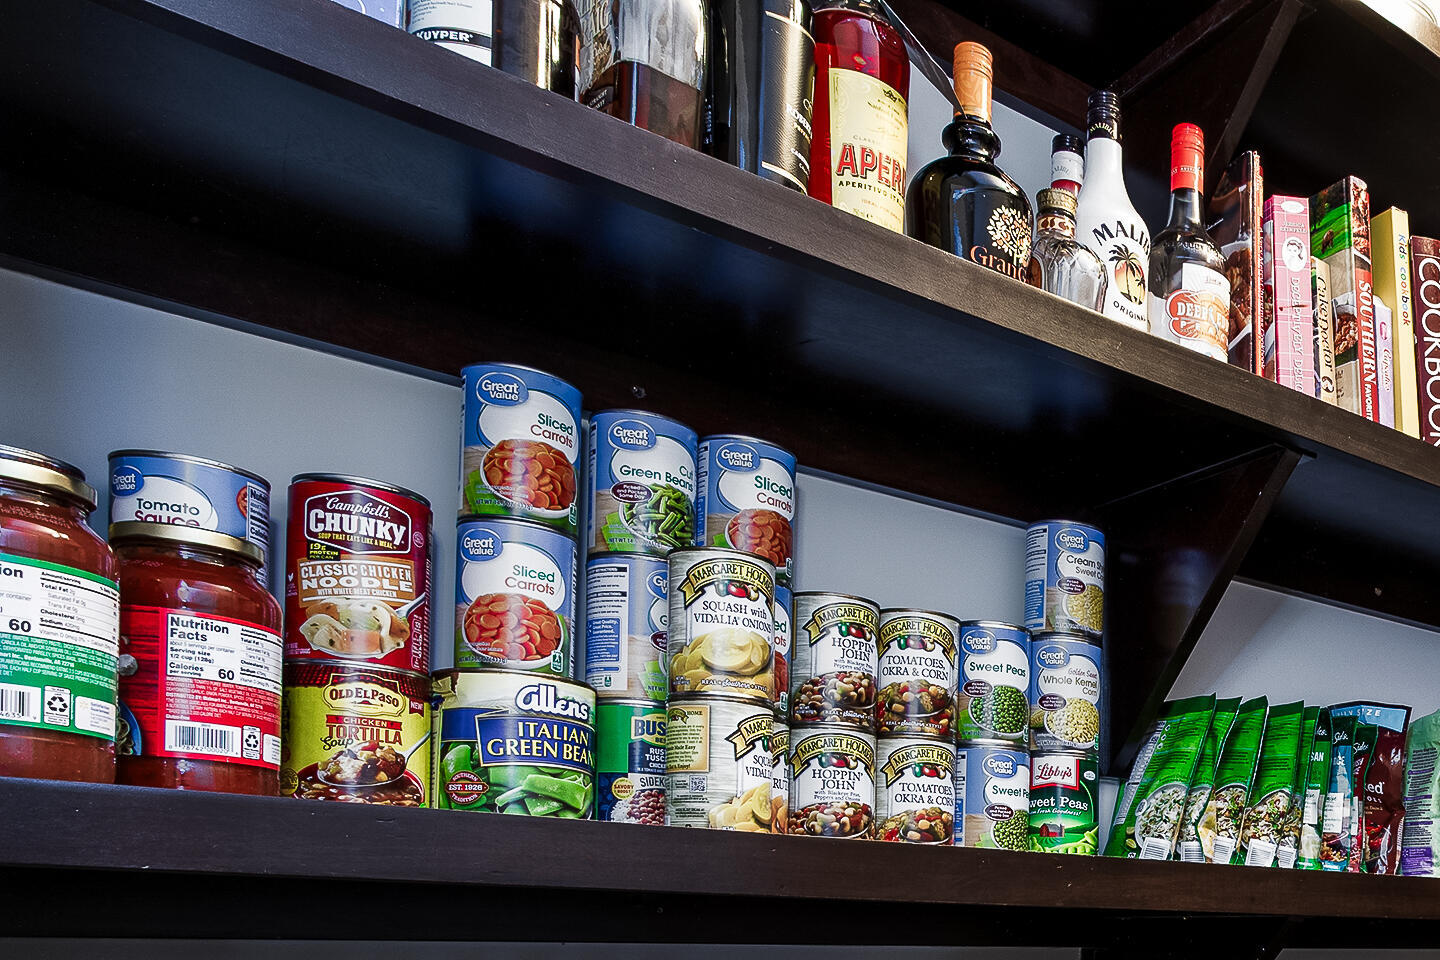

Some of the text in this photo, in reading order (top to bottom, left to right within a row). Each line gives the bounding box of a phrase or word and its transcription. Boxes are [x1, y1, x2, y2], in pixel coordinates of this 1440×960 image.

[1092, 220, 1150, 256] MALIB
[1398, 234, 1410, 326] Kids' cookbook
[1358, 280, 1377, 385] SOUTHERN
[482, 379, 519, 394] Great
[489, 389, 519, 401] Value
[537, 412, 573, 436] Sliced
[530, 425, 573, 448] Carrots
[613, 426, 649, 439] Great
[620, 436, 649, 446] Value
[721, 450, 753, 461] Great
[728, 458, 753, 467] Value
[112, 473, 136, 484] Great
[620, 464, 693, 492] Green Beans
[679, 465, 693, 480] Cut
[115, 480, 136, 490] Value
[754, 475, 793, 500] Sliced
[136, 498, 200, 516] Tomato
[757, 493, 792, 513] Carrots
[309, 509, 406, 545] CHUNKY
[464, 537, 494, 548] Great
[1060, 533, 1084, 544] Great
[469, 546, 493, 556] Value
[1066, 555, 1096, 568] Cream
[301, 564, 411, 581] CLASSIC CHICKEN
[512, 565, 555, 583] Sliced
[692, 563, 744, 583] MARGARET
[302, 576, 413, 592] NOODLE
[504, 577, 555, 595] Carrots
[702, 601, 747, 615] SQUASH
[694, 613, 738, 626] VIDALIA
[742, 617, 772, 634] ONIONS
[817, 608, 862, 624] MARGARET
[9, 618, 32, 633] 60
[170, 617, 229, 634] Nutrition
[881, 621, 951, 645] MARGARET HOLMES
[170, 628, 208, 642] Facts
[965, 636, 991, 644] Great
[169, 646, 211, 657] Serving size
[832, 637, 875, 653] HOPPIN'
[841, 648, 870, 662] JOHN
[1040, 651, 1065, 660] Great
[169, 661, 204, 672] Calories
[882, 667, 948, 680] OKRA CORN
[969, 662, 1026, 677] Sweet Peas
[218, 669, 235, 681] 60
[1043, 675, 1098, 689] Whole Kernel
[1082, 687, 1098, 697] Corn
[343, 717, 387, 727] CHICKEN
[326, 724, 402, 746] TORTILLA
[517, 722, 589, 747] ITALIAN
[320, 736, 354, 752] Soup
[800, 737, 844, 757] MARGARET
[847, 740, 873, 760] HOLMES
[487, 739, 594, 768] GREEN BEAN
[893, 749, 937, 765] MARGARET
[987, 759, 1013, 768] Great
[812, 769, 863, 781] HOPPIN'
[1035, 763, 1073, 780] Libby's
[821, 779, 856, 790] JOHN
[992, 785, 1021, 796] Sweet
[894, 793, 925, 804] OKRA
[1059, 796, 1088, 811] Peas
